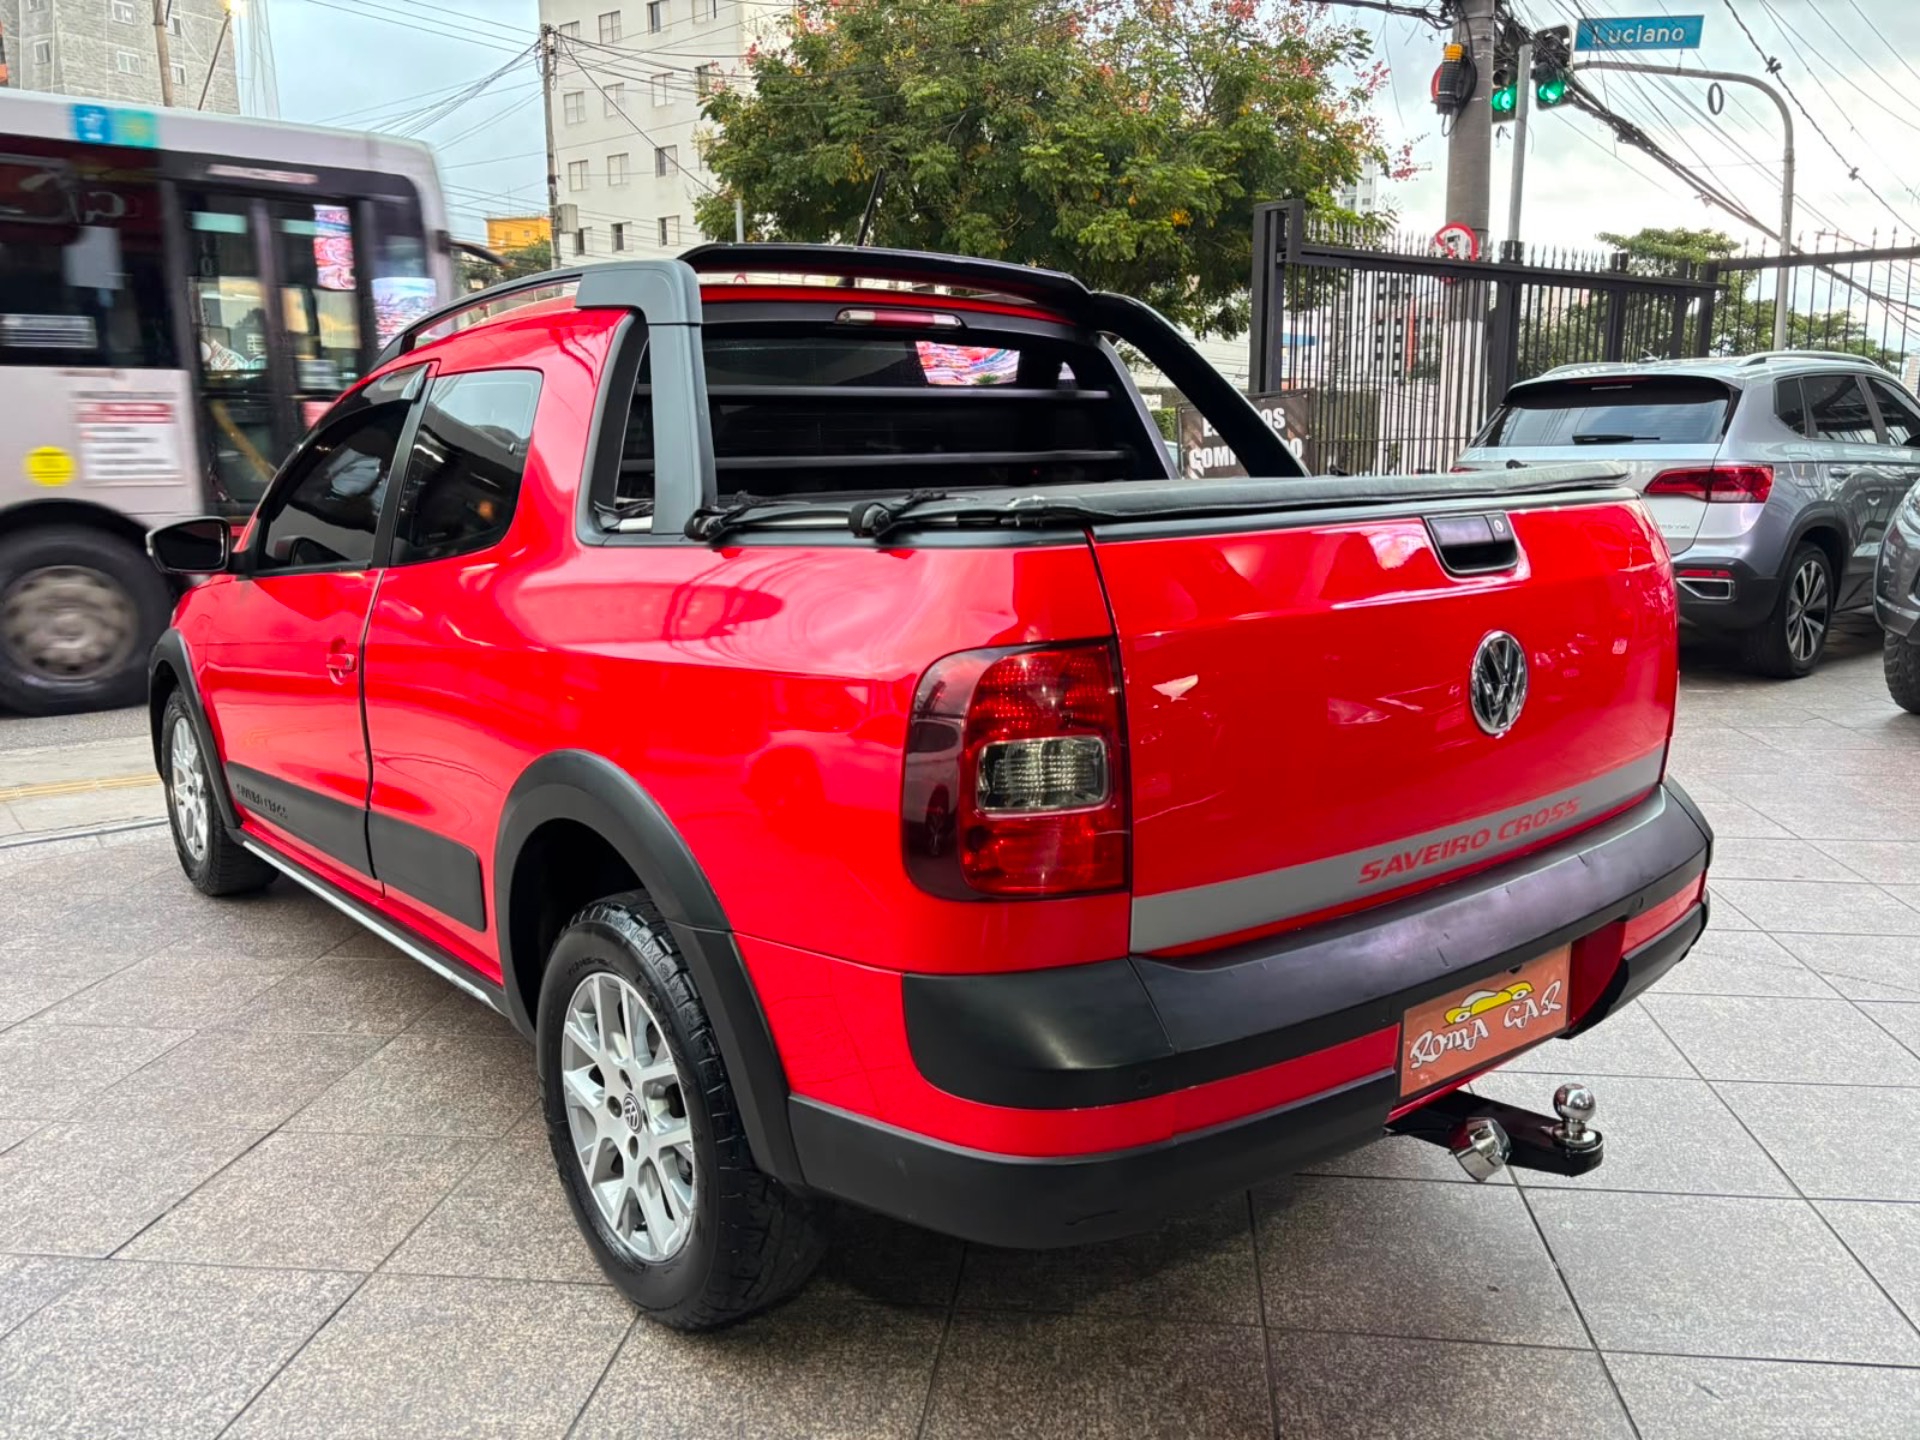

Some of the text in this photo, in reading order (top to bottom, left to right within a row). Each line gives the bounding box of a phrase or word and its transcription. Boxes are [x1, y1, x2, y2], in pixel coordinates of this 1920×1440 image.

[1592, 24, 1685, 44] Luciano
[1358, 797, 1582, 884] SAVEIRO CROSS
